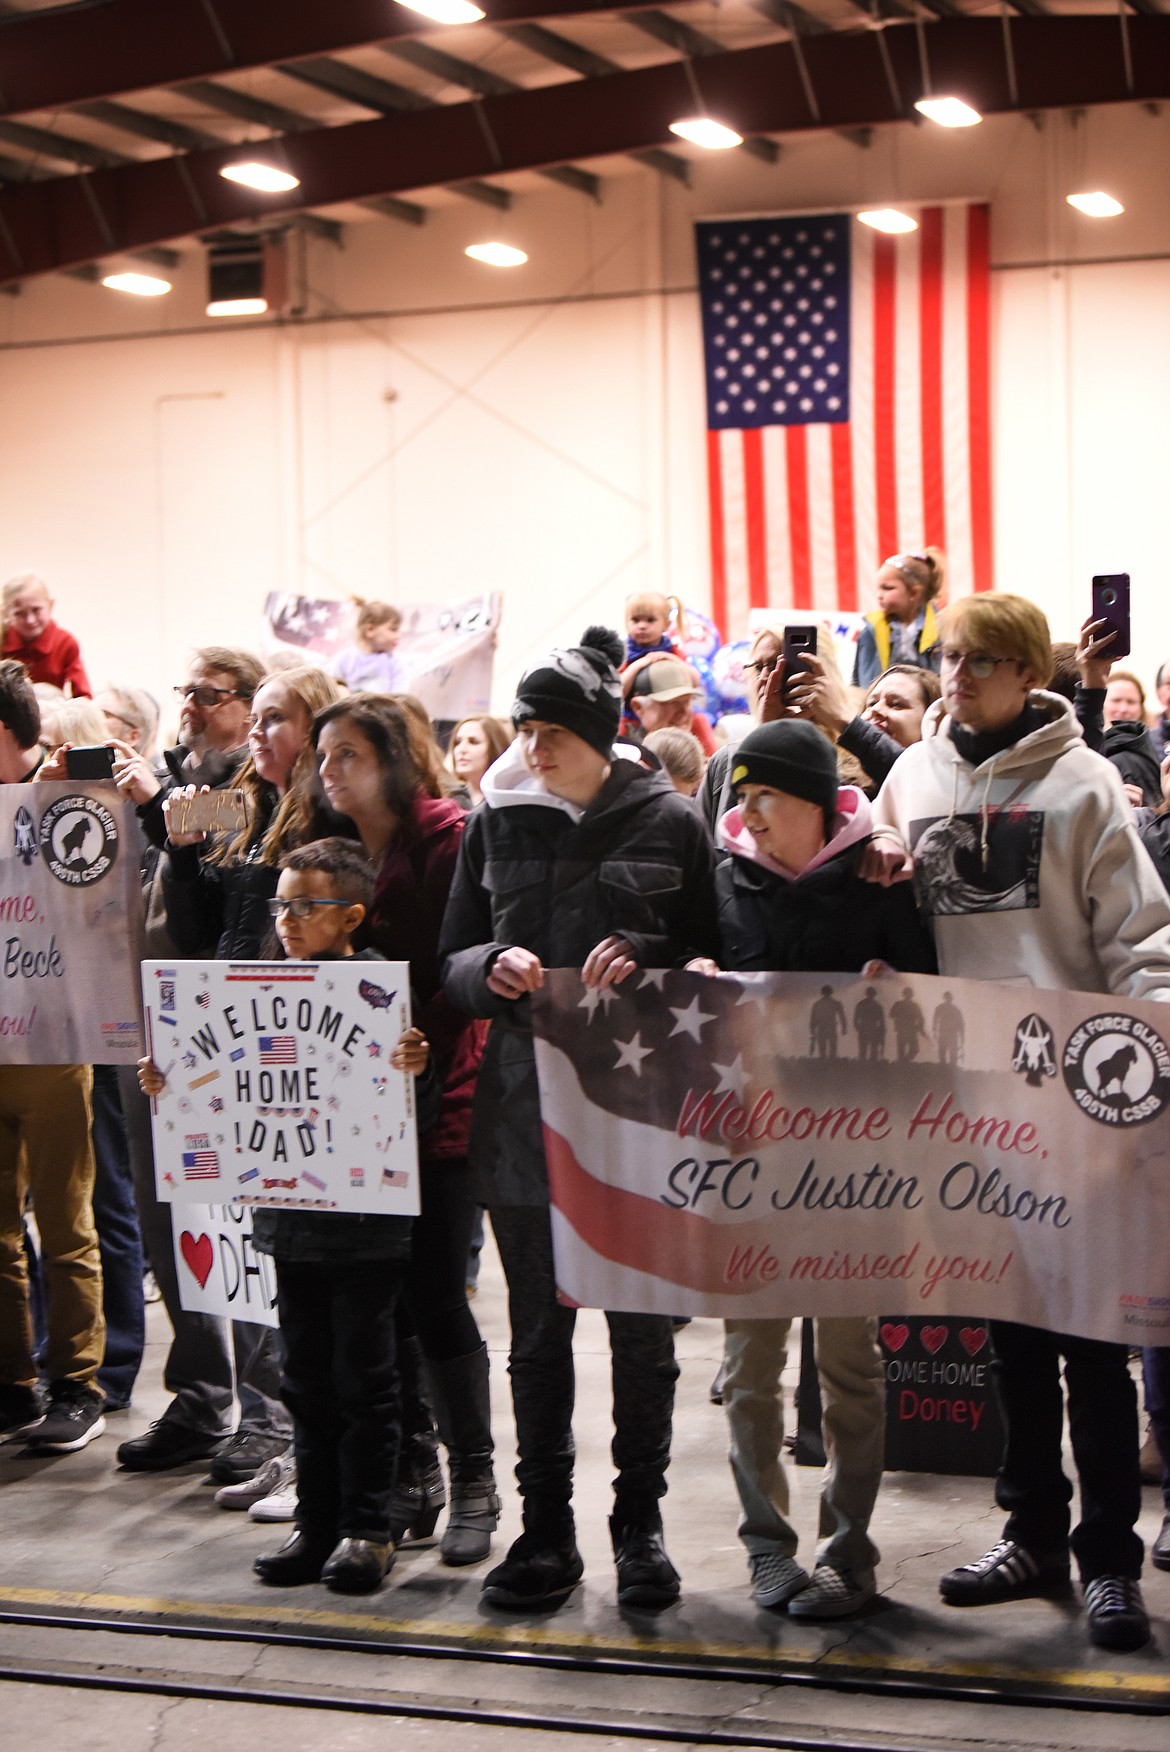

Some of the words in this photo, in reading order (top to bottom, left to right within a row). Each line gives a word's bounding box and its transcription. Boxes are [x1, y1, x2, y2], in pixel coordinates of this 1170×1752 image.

[51, 797, 85, 815] FORCE
[85, 799, 118, 841] GLACIER
[3, 934, 66, 979] Beck
[191, 996, 366, 1060] WELCOME
[1064, 1028, 1089, 1067] TASK
[1086, 1016, 1132, 1035] FORCE
[1132, 1022, 1170, 1078] GLACIER
[235, 1067, 321, 1104] HOME
[1121, 1094, 1162, 1122] CSSB
[676, 1088, 893, 1141] Welcome
[907, 1090, 1048, 1160] Home,
[659, 1157, 761, 1210] SFC
[770, 1158, 924, 1210] Justin
[939, 1160, 1073, 1229] Olson
[723, 1243, 780, 1283] We
[788, 1241, 920, 1281] missed
[918, 1249, 1013, 1300] you!
[881, 1360, 928, 1383] OME
[931, 1361, 987, 1387] HOME
[898, 1389, 986, 1432] Doney
